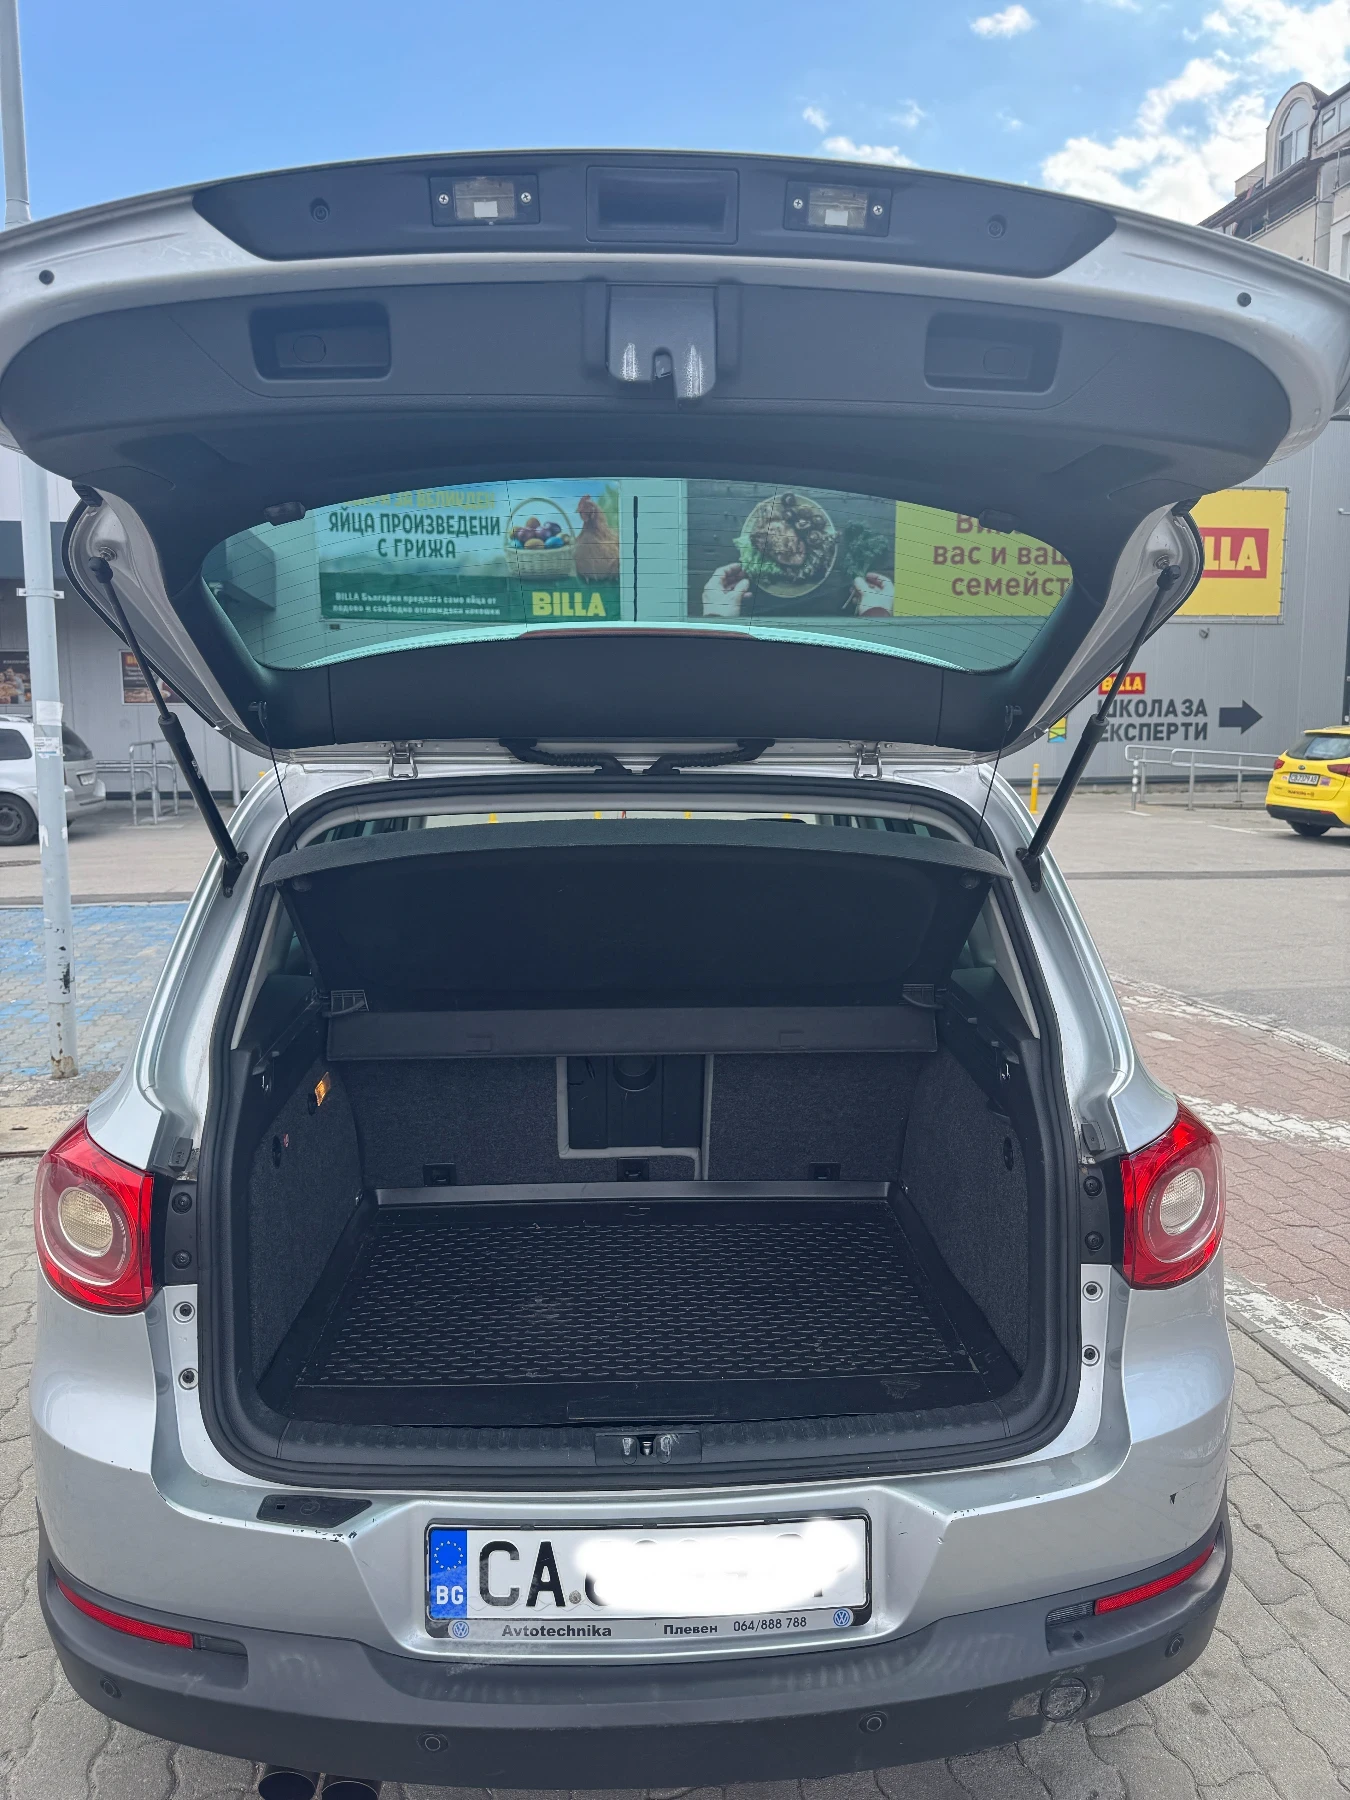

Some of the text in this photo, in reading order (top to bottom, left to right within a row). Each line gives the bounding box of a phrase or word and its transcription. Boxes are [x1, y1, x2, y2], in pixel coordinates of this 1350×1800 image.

[329, 506, 501, 538] ЯЙЦА ПРОИЗВЕДЕНИ
[377, 538, 456, 559] С ГРИЖА
[933, 546, 981, 565] вас
[991, 547, 1007, 565] и
[532, 592, 606, 616] BILLA
[1181, 699, 1208, 717] ЗА
[436, 1586, 464, 1605] BG
[501, 1625, 612, 1637] Avtotechnika
[663, 1616, 807, 1635] Плевен 064/888 788
